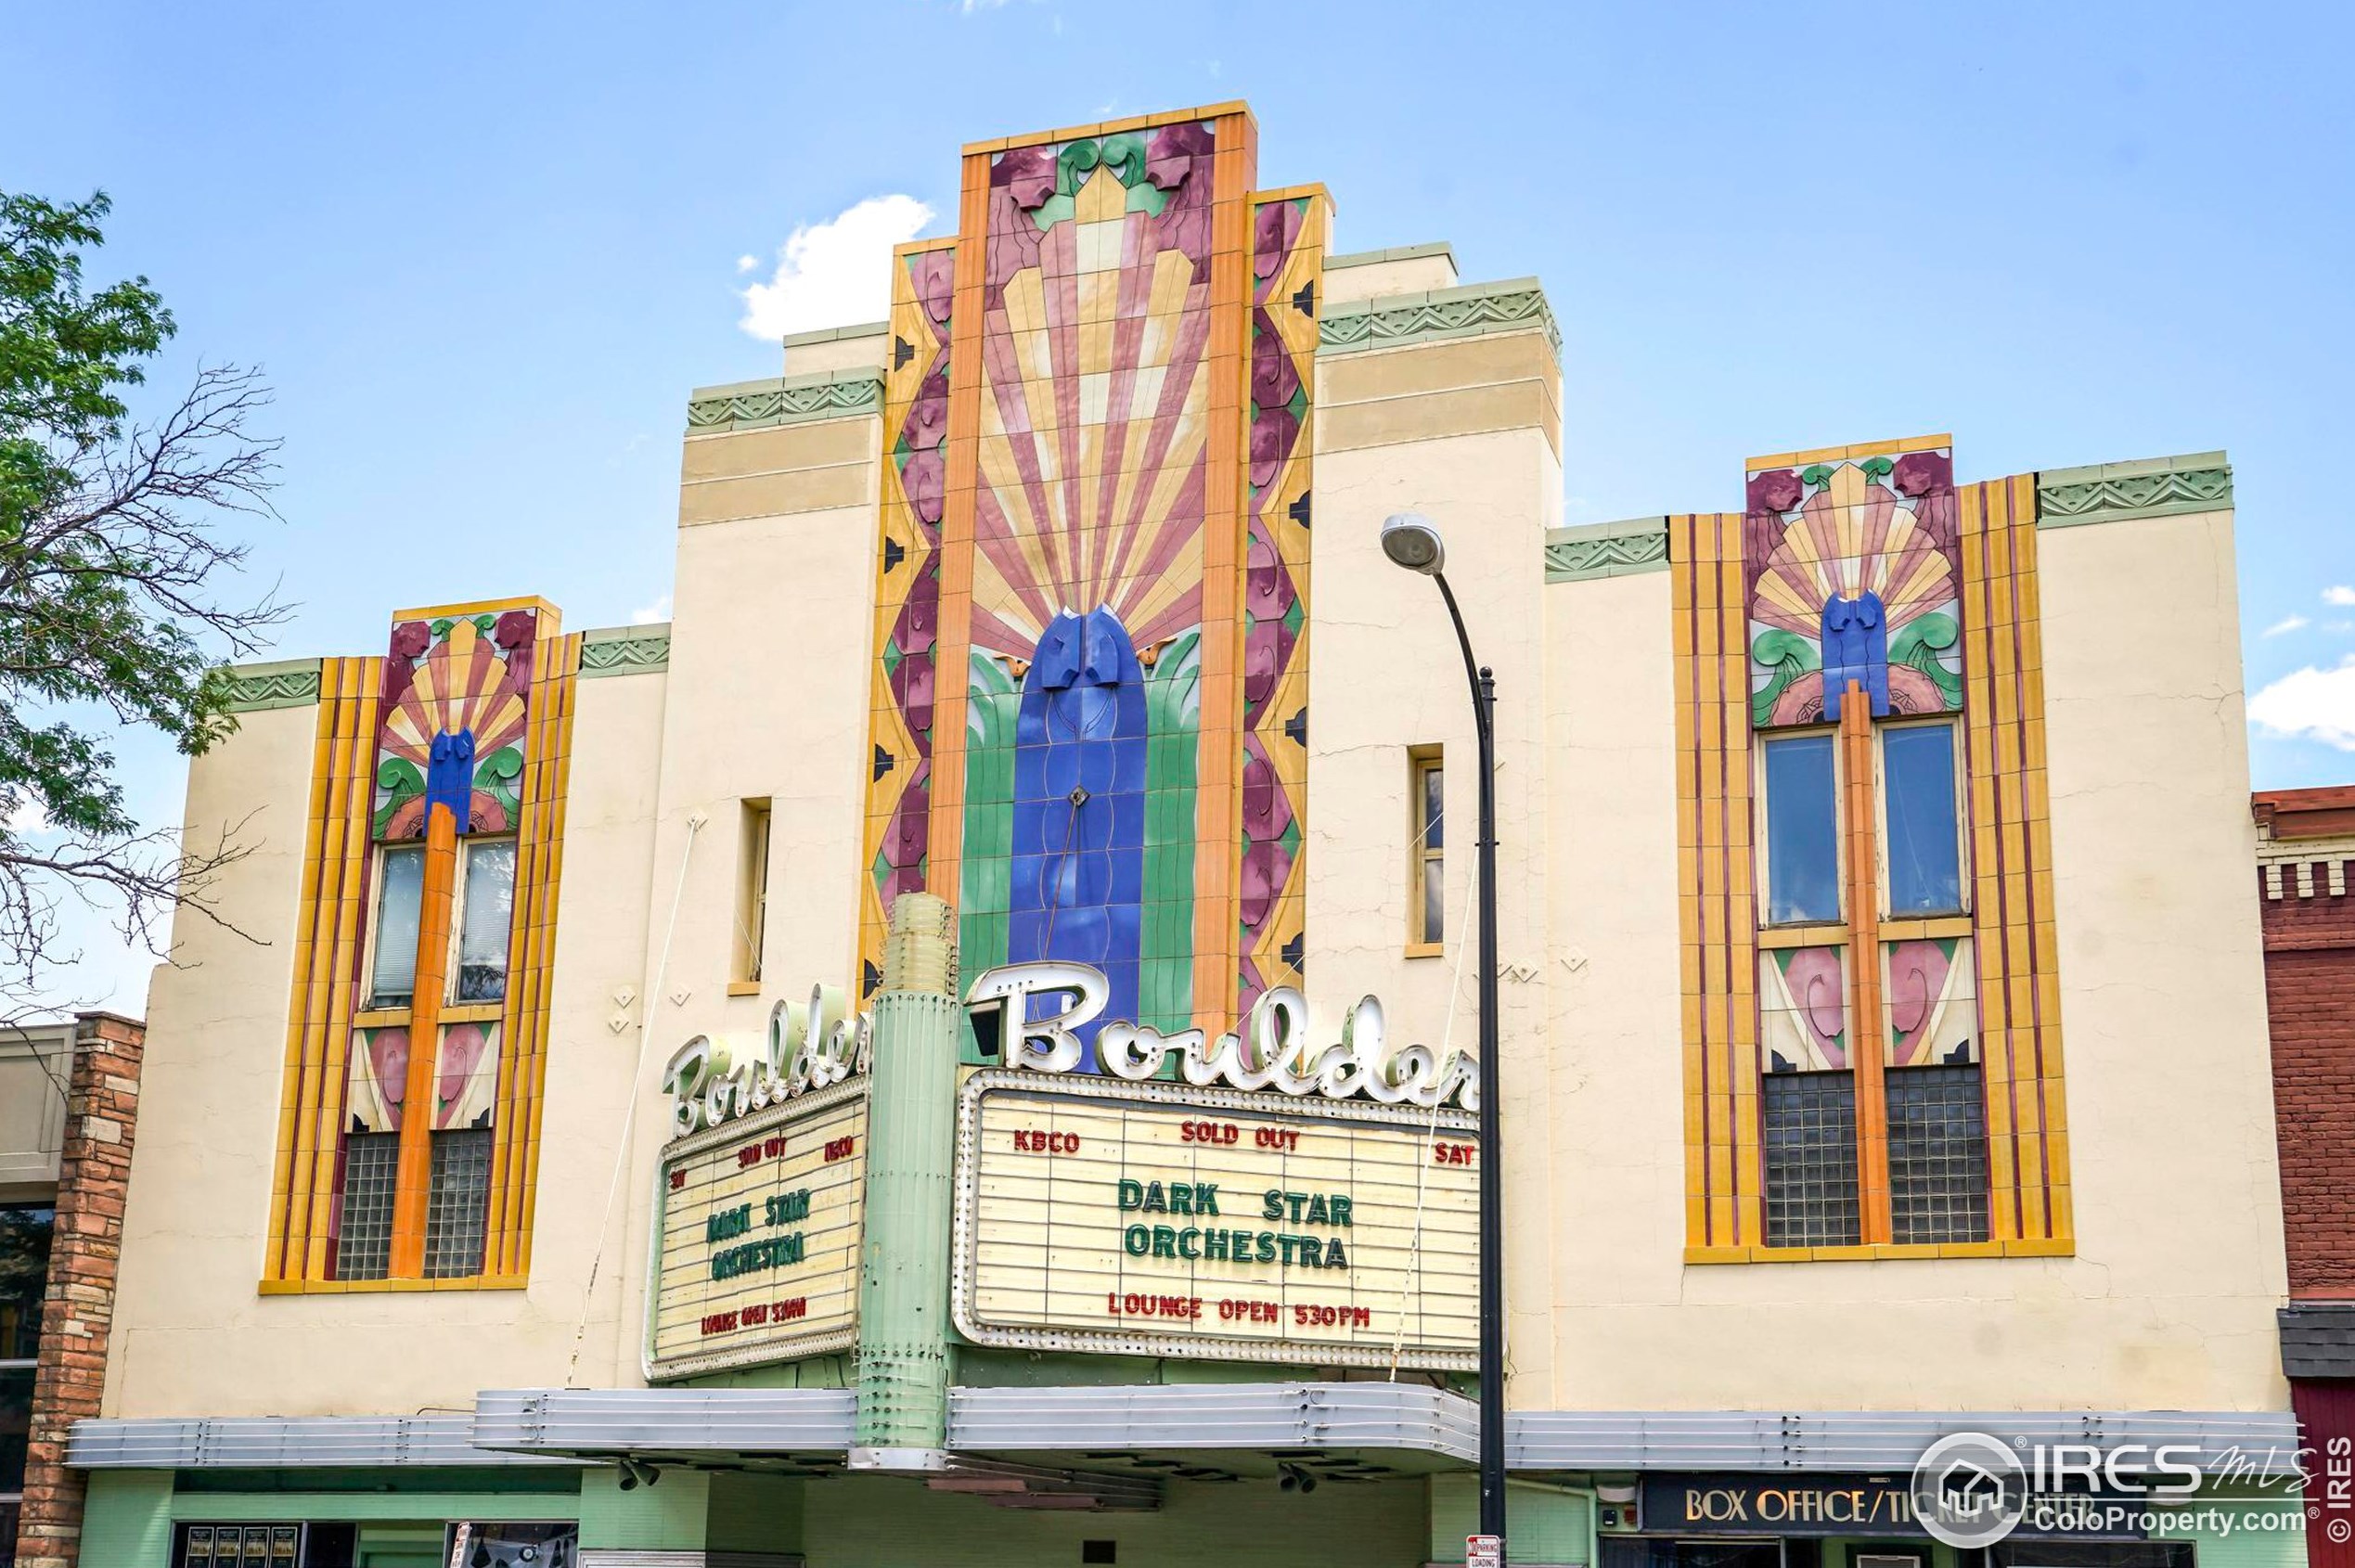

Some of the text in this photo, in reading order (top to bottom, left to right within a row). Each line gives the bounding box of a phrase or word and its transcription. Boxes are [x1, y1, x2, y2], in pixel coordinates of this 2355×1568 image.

[963, 960, 1480, 1112] Boulder
[1014, 1129, 1080, 1154] KBCO
[1181, 1120, 1300, 1150] SOLD OUT
[1435, 1142, 1475, 1166] SAT
[765, 1188, 811, 1227] STAR
[1118, 1178, 1353, 1227] DARK STAR
[1125, 1224, 1348, 1270] ORCHESTRA
[1108, 1292, 1371, 1329] LOUNGE OPEN 530PM
[1686, 1490, 1748, 1522] BOX
